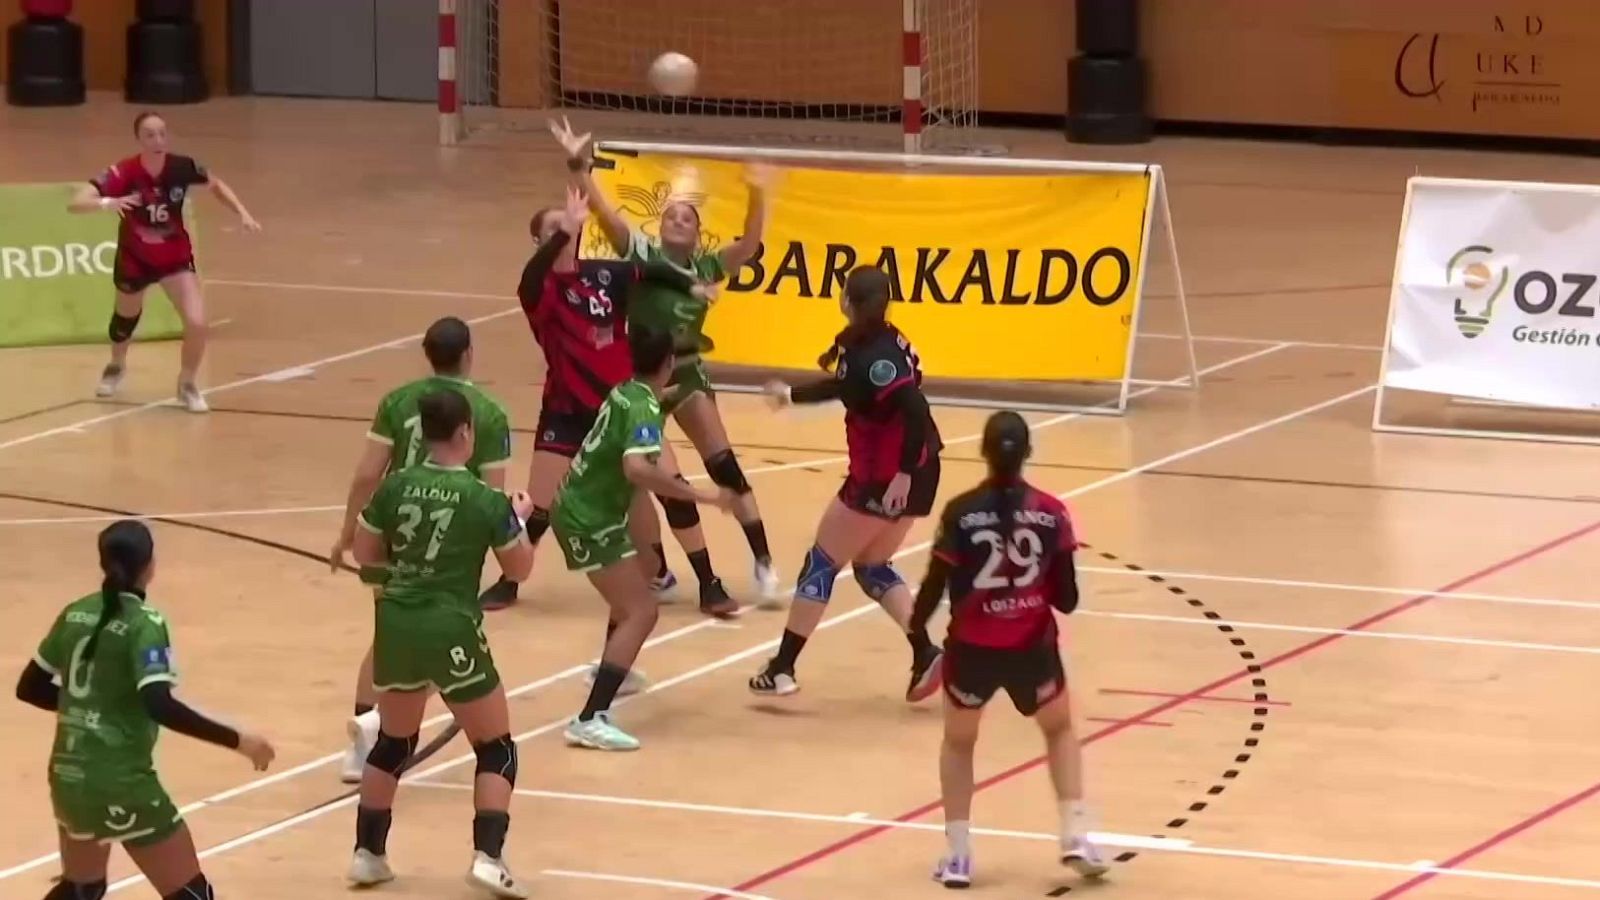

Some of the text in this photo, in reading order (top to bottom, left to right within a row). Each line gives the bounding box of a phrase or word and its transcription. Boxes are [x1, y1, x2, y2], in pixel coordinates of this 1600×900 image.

[146, 203, 169, 222] 16
[725, 236, 1131, 306] BARAKALDO
[1514, 270, 1600, 317] OZ
[1512, 325, 1590, 346] Gestión
[392, 504, 455, 560] 31
[970, 529, 1043, 589] 29
